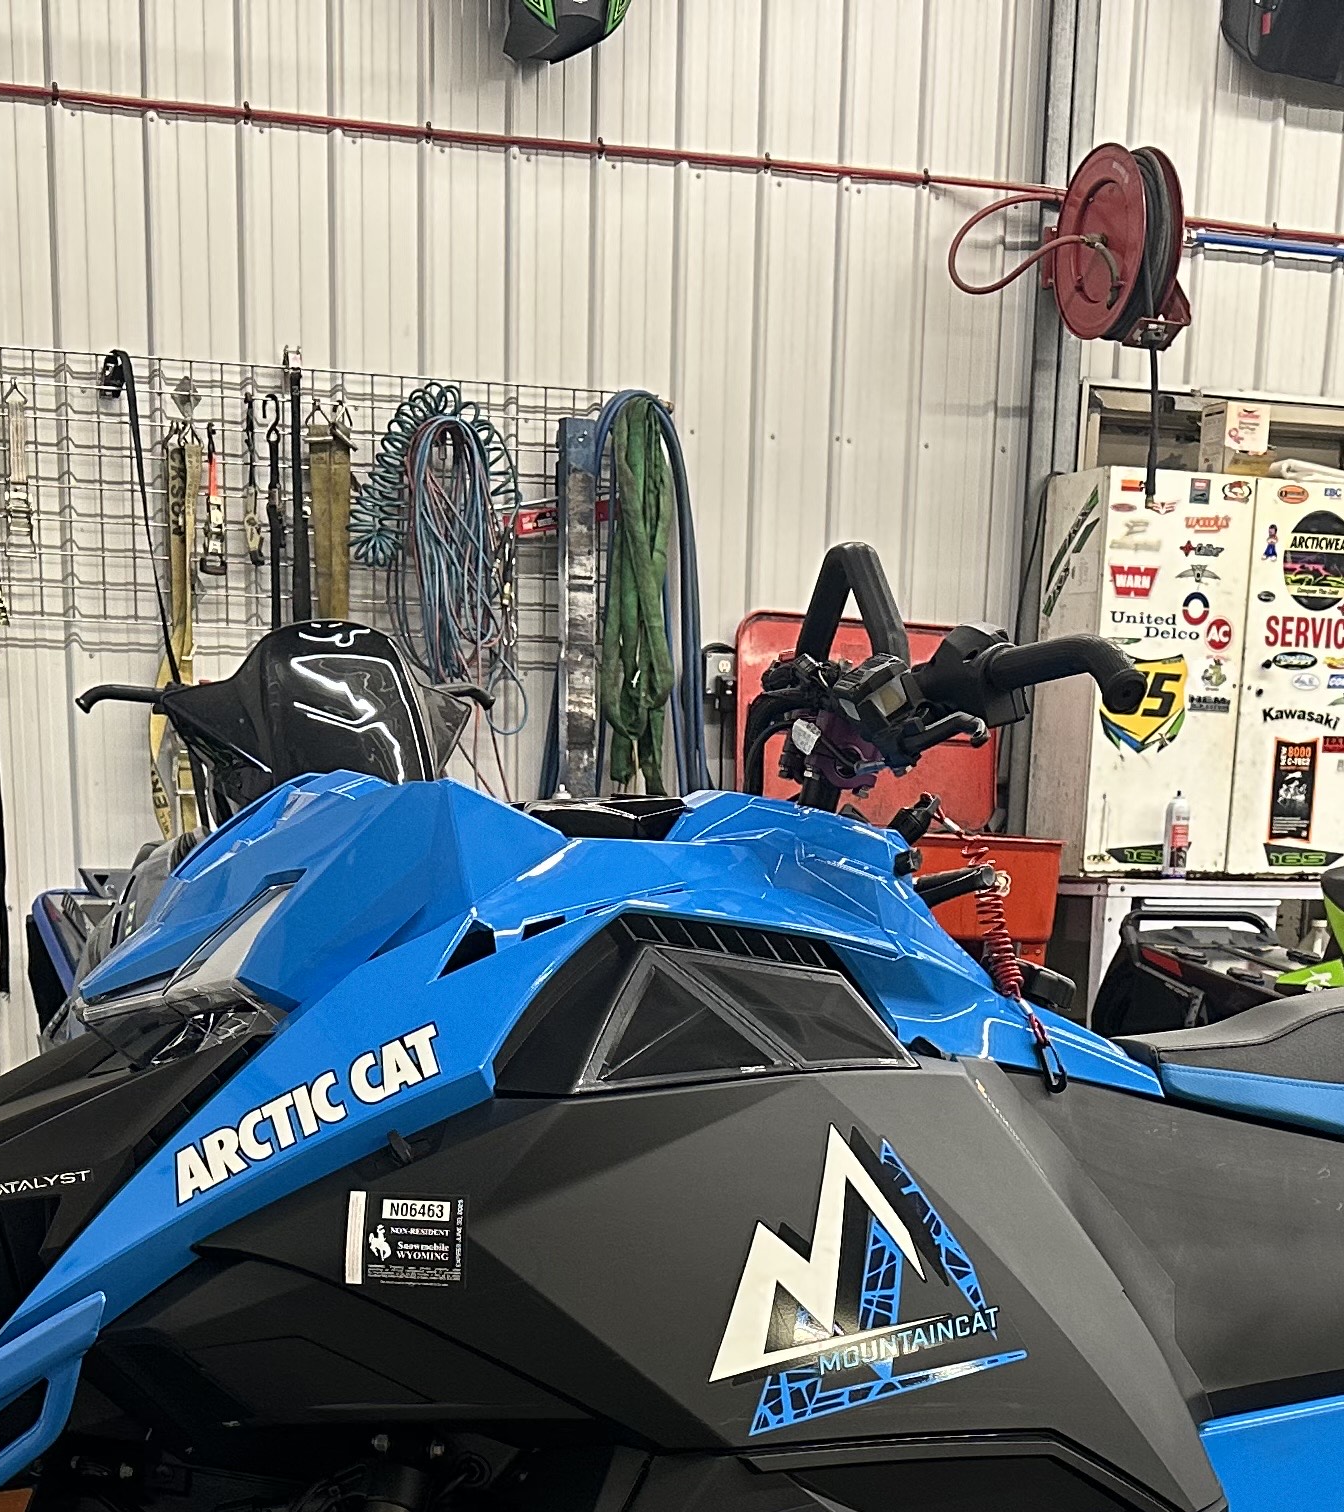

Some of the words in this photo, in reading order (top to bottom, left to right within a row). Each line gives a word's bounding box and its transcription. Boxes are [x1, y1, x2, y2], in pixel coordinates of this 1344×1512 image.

[1115, 575, 1152, 589] WARN
[1110, 610, 1177, 626] United
[1144, 626, 1200, 641] Delco
[1206, 625, 1232, 643] AC
[1262, 707, 1340, 731] Kawasaki
[1288, 746, 1312, 757] 8000
[1270, 852, 1327, 865] 165
[175, 1069, 348, 1206] ARCTIC
[349, 1021, 441, 1103] CAT
[389, 1202, 445, 1219] N06463
[390, 1226, 451, 1237] NON-RESIDENT
[396, 1250, 450, 1261] WYOMING
[819, 1306, 999, 1376] MOUNTAINCAT
